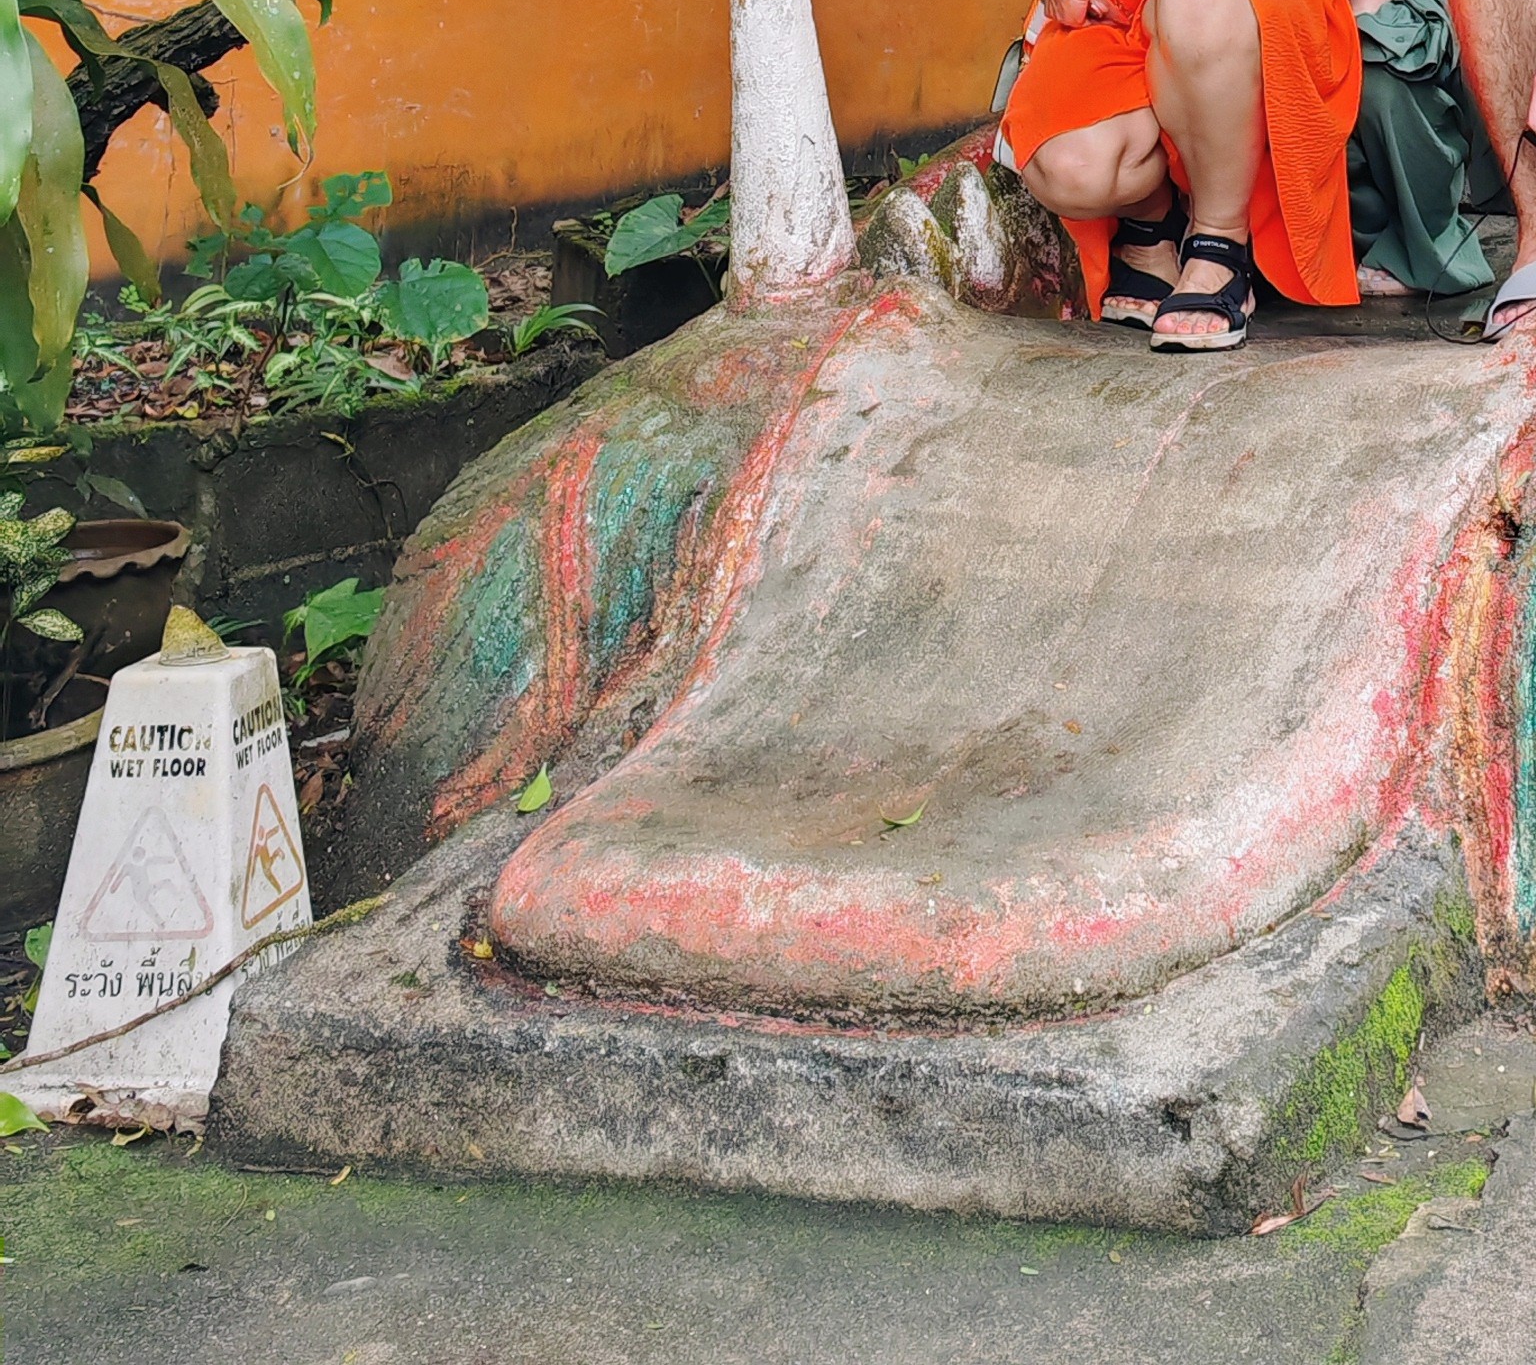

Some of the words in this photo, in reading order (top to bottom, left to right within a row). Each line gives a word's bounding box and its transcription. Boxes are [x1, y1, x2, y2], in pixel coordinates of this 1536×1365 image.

[233, 694, 282, 746] CAUTION
[110, 758, 145, 778] WET
[152, 757, 206, 777] FLOOR
[235, 744, 253, 770] WET
[257, 727, 283, 758] FLOOR
[65, 958, 122, 999] ระวัง
[136, 945, 213, 998] พื้นลน
